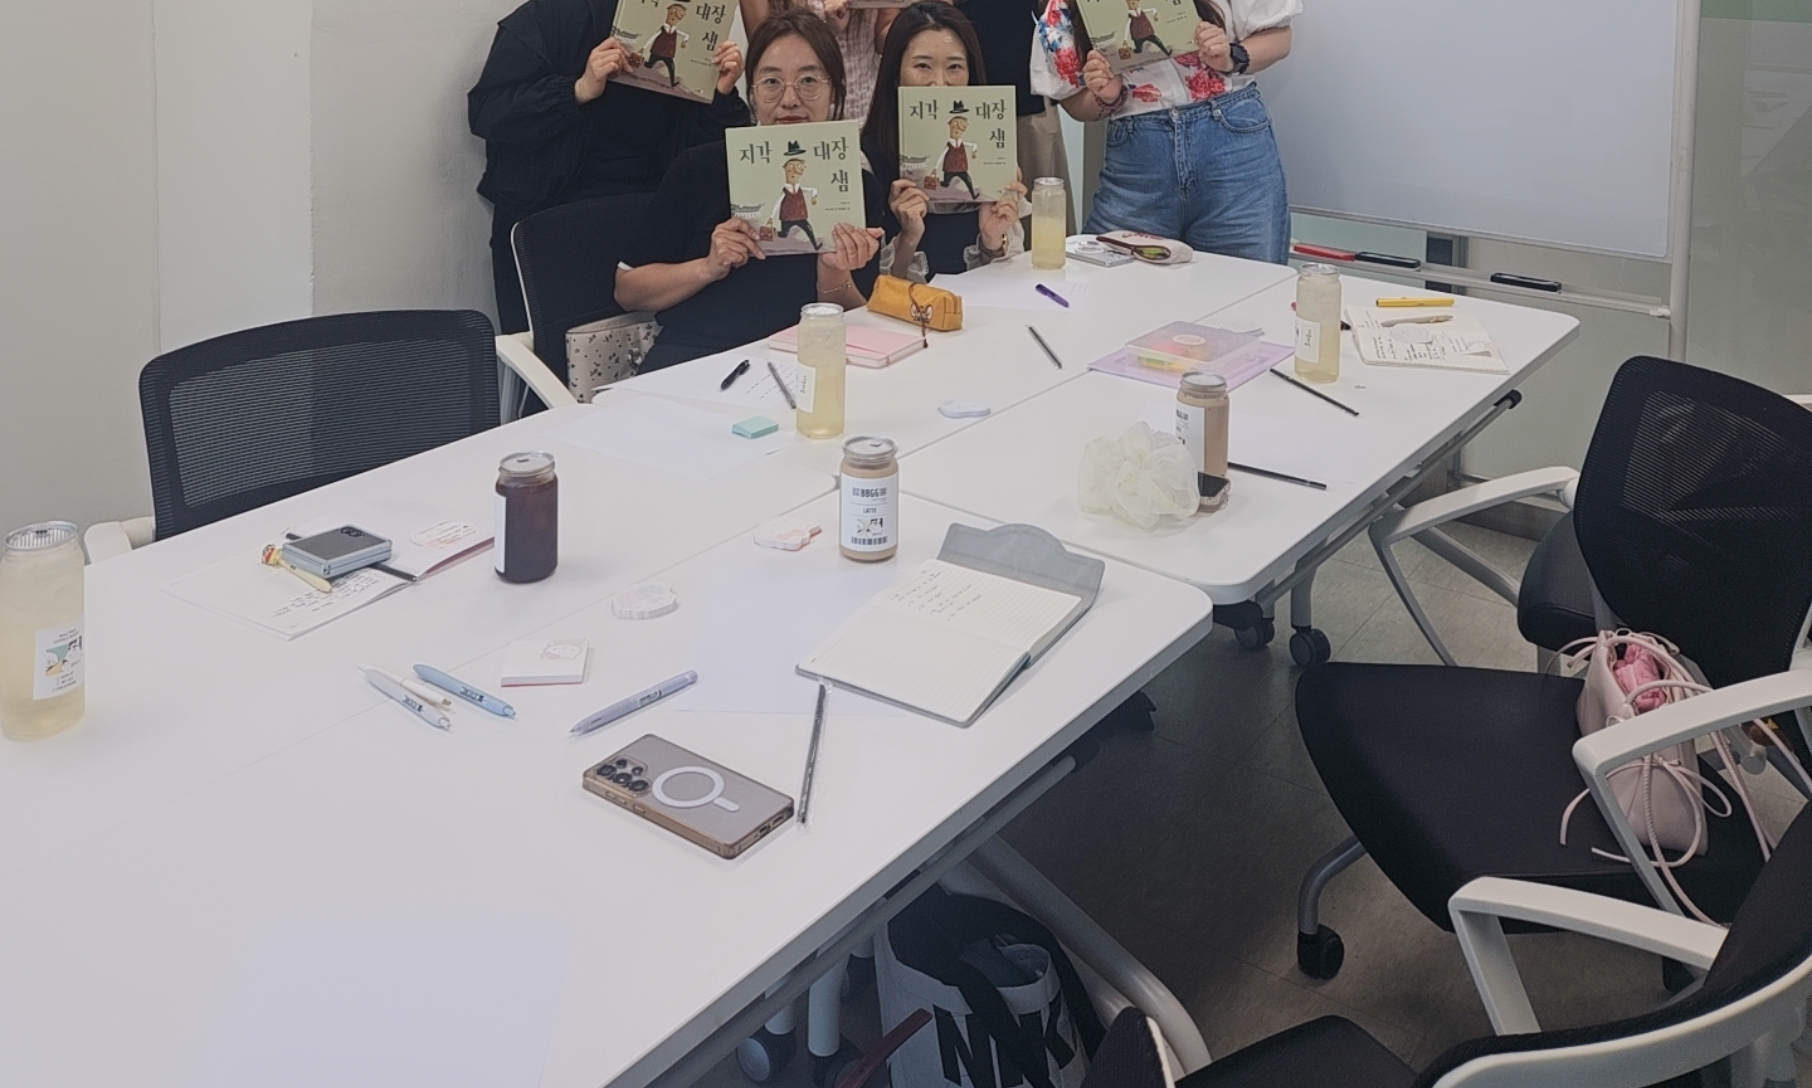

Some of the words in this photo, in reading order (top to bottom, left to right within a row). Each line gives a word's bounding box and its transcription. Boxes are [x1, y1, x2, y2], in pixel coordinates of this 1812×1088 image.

[695, 2, 726, 24] 대장
[701, 30, 718, 51] 샘
[909, 98, 939, 120] 지각
[975, 98, 1007, 120] 대장
[989, 127, 1005, 149] 샘
[739, 140, 773, 164] 지각
[813, 136, 849, 161] 대장
[830, 169, 849, 192] 샘
